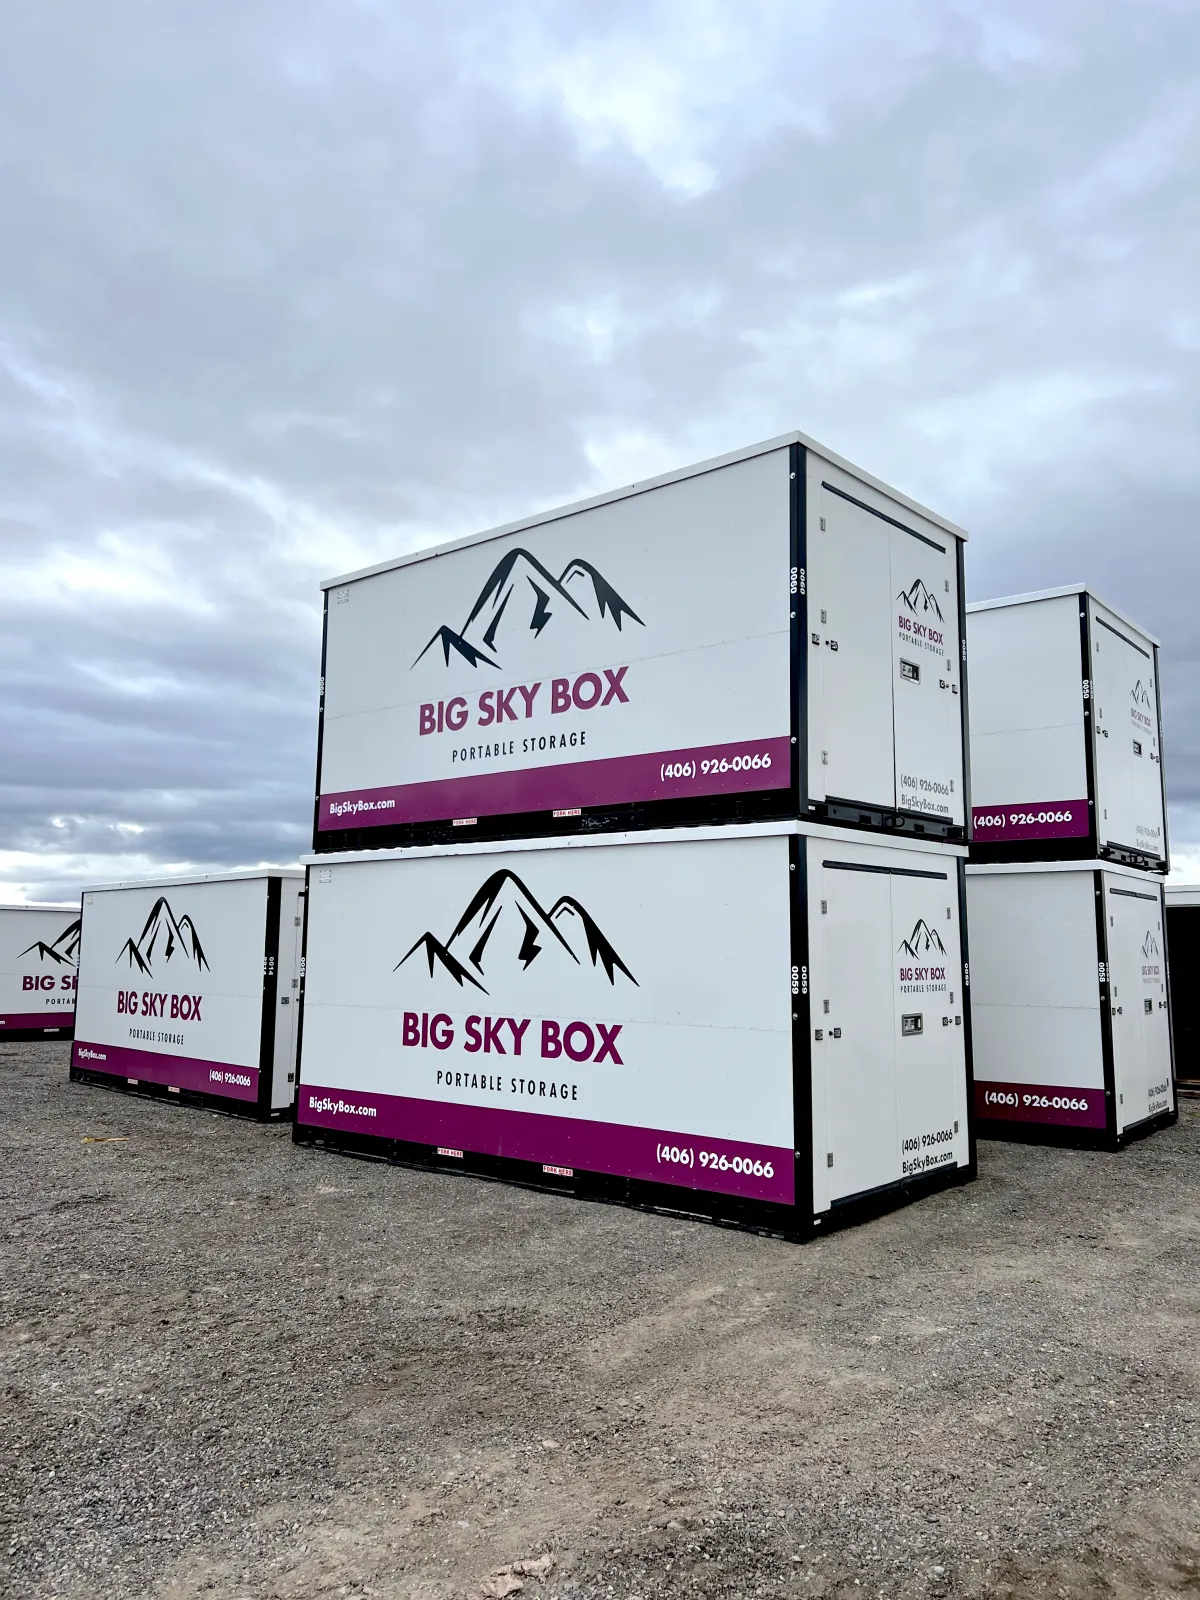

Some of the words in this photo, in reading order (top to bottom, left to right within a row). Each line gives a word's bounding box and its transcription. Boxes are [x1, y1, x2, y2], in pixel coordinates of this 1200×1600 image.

[898, 616, 912, 631] BIG
[913, 622, 927, 638] SKY
[929, 628, 944, 646] BOX
[899, 632, 922, 648] PORTABLE
[924, 642, 944, 656] STORAGE
[419, 697, 469, 736] BIG
[478, 682, 542, 727] SKY
[551, 666, 630, 714] BOX
[452, 742, 514, 763] PORTABLE
[522, 731, 587, 753] STORAGE
[660, 761, 696, 782] (406)
[700, 753, 772, 776] 926-0066
[900, 774, 918, 791] (406)
[920, 779, 949, 796] 926-0066
[329, 798, 396, 817] BigSkyBox.com
[902, 794, 948, 813] BigSkyBox.com
[974, 815, 1006, 828] (406)
[1010, 811, 1072, 824] 926-0066
[22, 975, 56, 990] BIG
[900, 968, 913, 981] BIG
[914, 968, 929, 980] SKY
[930, 967, 946, 980] BOX
[900, 985, 924, 993] PORTABLE
[926, 984, 946, 992] STORAGE
[117, 991, 138, 1015] BIG
[141, 992, 168, 1018] SKY
[170, 994, 202, 1022] BOX
[129, 1028, 156, 1042] PORTABLE
[158, 1032, 184, 1045] STORAGE
[402, 1012, 454, 1050] BIG
[464, 1014, 532, 1056] SKY
[541, 1020, 624, 1066] BOX
[209, 1070, 224, 1084] (406)
[224, 1072, 250, 1086] 926-0066
[436, 1070, 502, 1092] PORTABLE
[511, 1078, 578, 1101] STORAGE
[308, 1096, 377, 1119] BigSkyBox.com
[984, 1091, 1019, 1107] (406)
[1022, 1095, 1088, 1110] 926-0066
[902, 1136, 920, 1155] (406)
[922, 1129, 952, 1147] 926-0066
[544, 1166, 557, 1174] FORK
[558, 1168, 572, 1176] HERE
[656, 1144, 694, 1168] (406)
[700, 1152, 774, 1179] 926-0066
[902, 1152, 952, 1174] BigSkyBox.com
